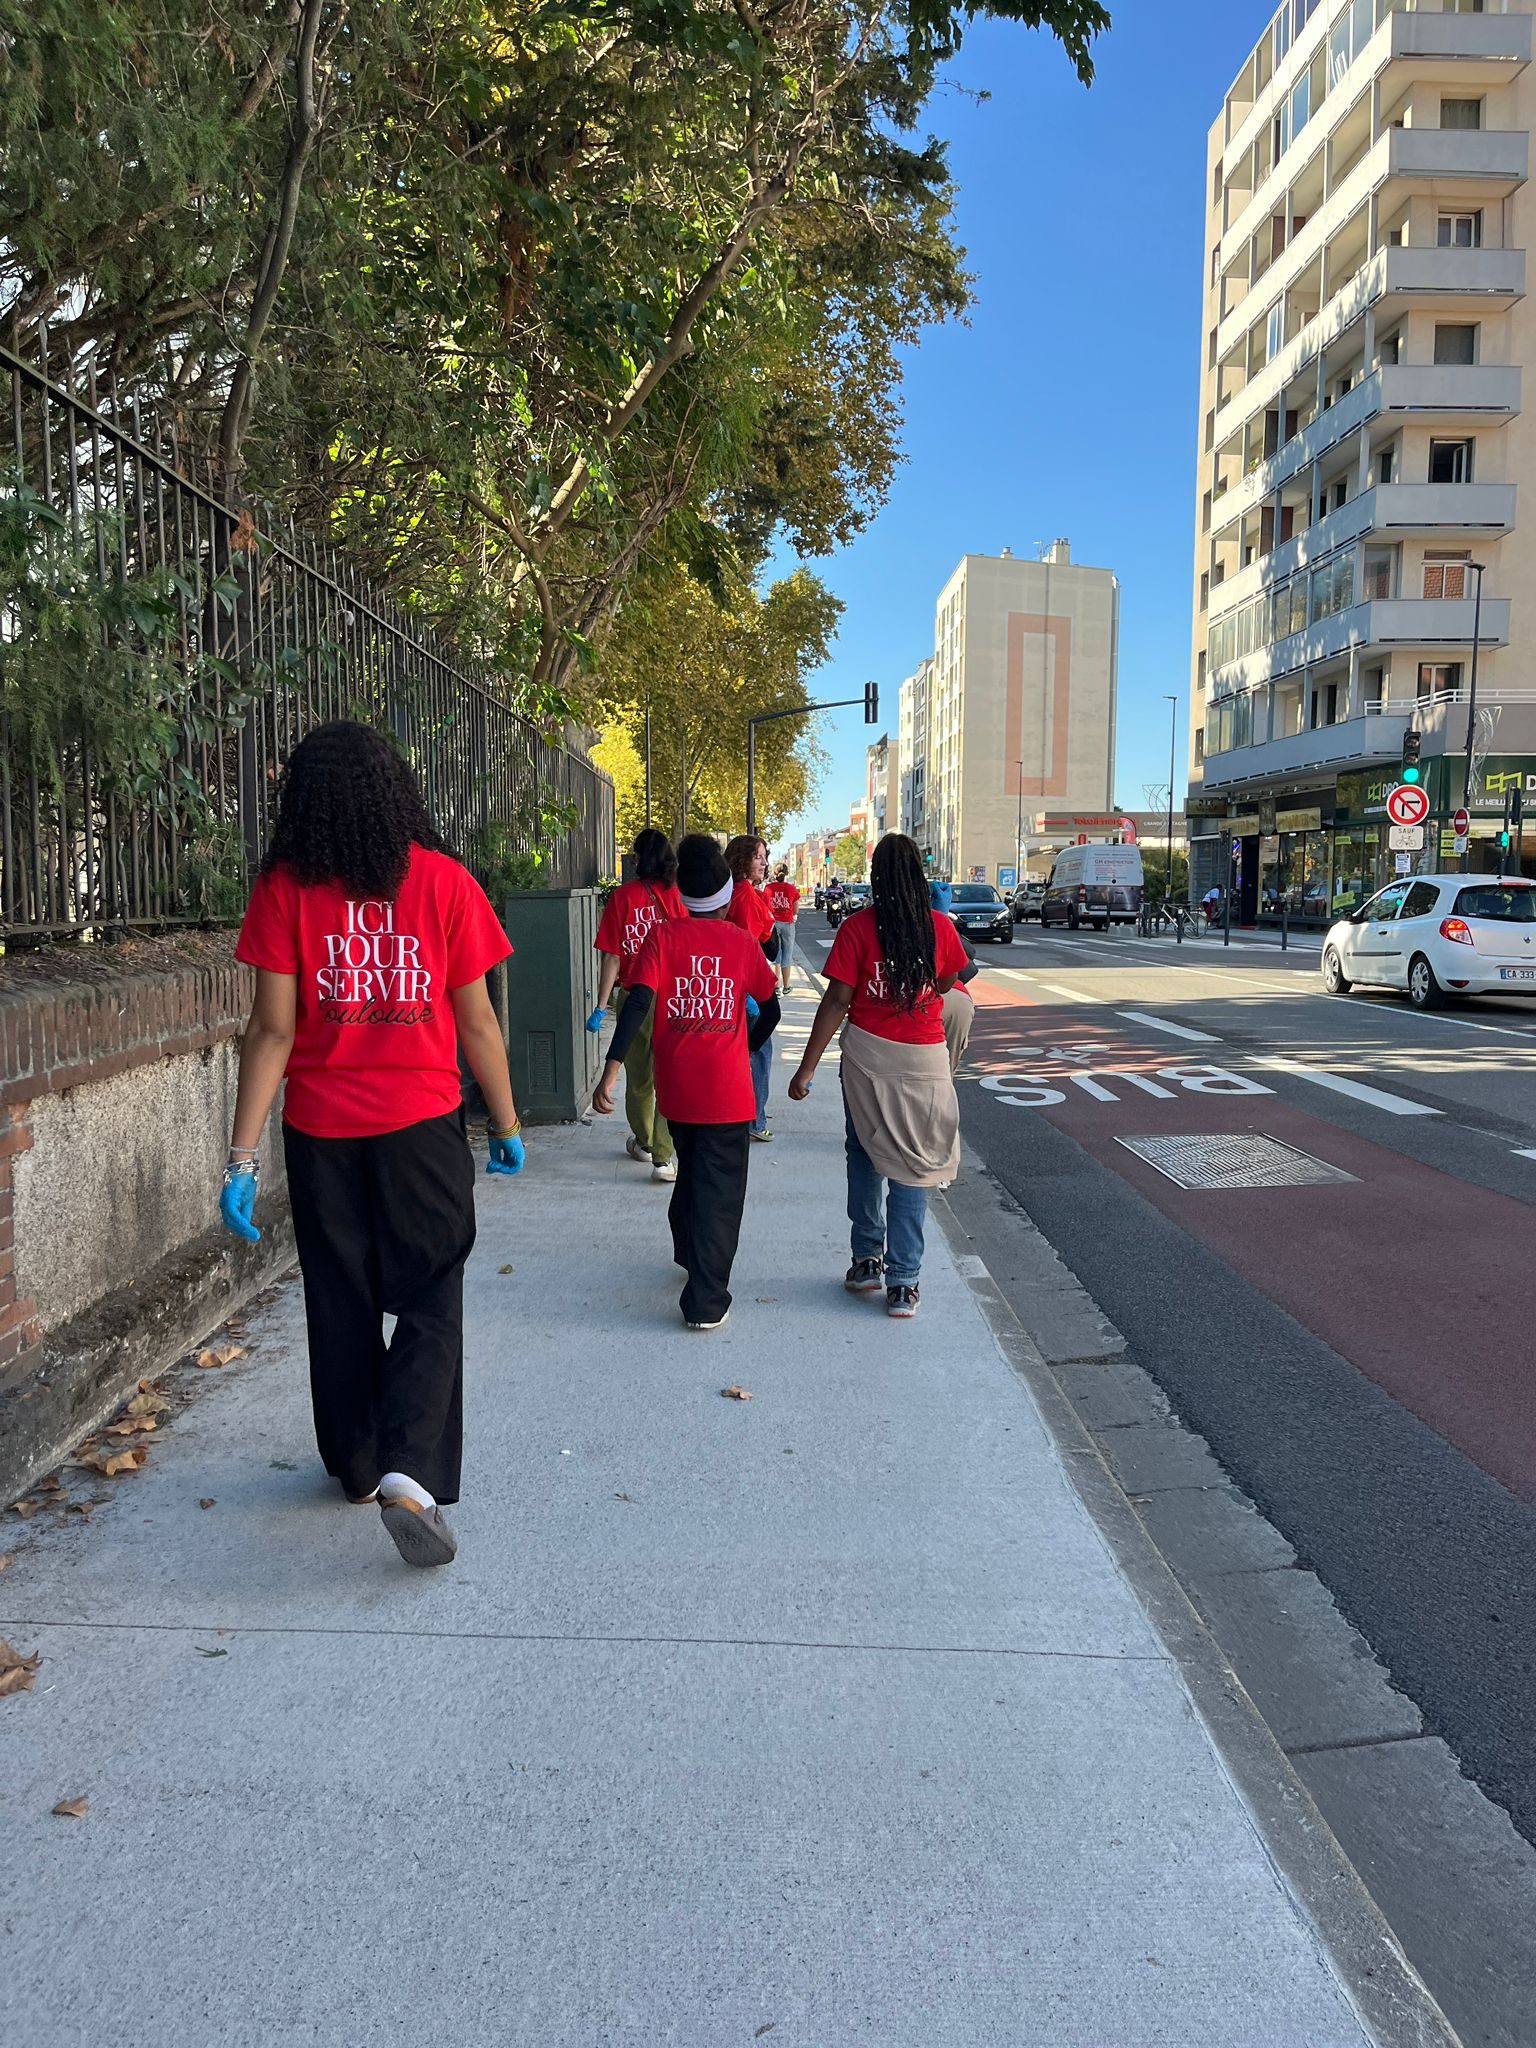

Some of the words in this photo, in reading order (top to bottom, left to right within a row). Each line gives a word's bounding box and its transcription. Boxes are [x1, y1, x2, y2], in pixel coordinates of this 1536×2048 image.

[344, 900, 394, 934] ICI
[633, 905, 656, 923] ICI
[324, 934, 423, 968] POUR
[689, 955, 722, 978] ICI
[316, 968, 433, 1002] SERVIR
[675, 976, 734, 1000] POUR
[979, 1064, 1278, 1107] BUS
